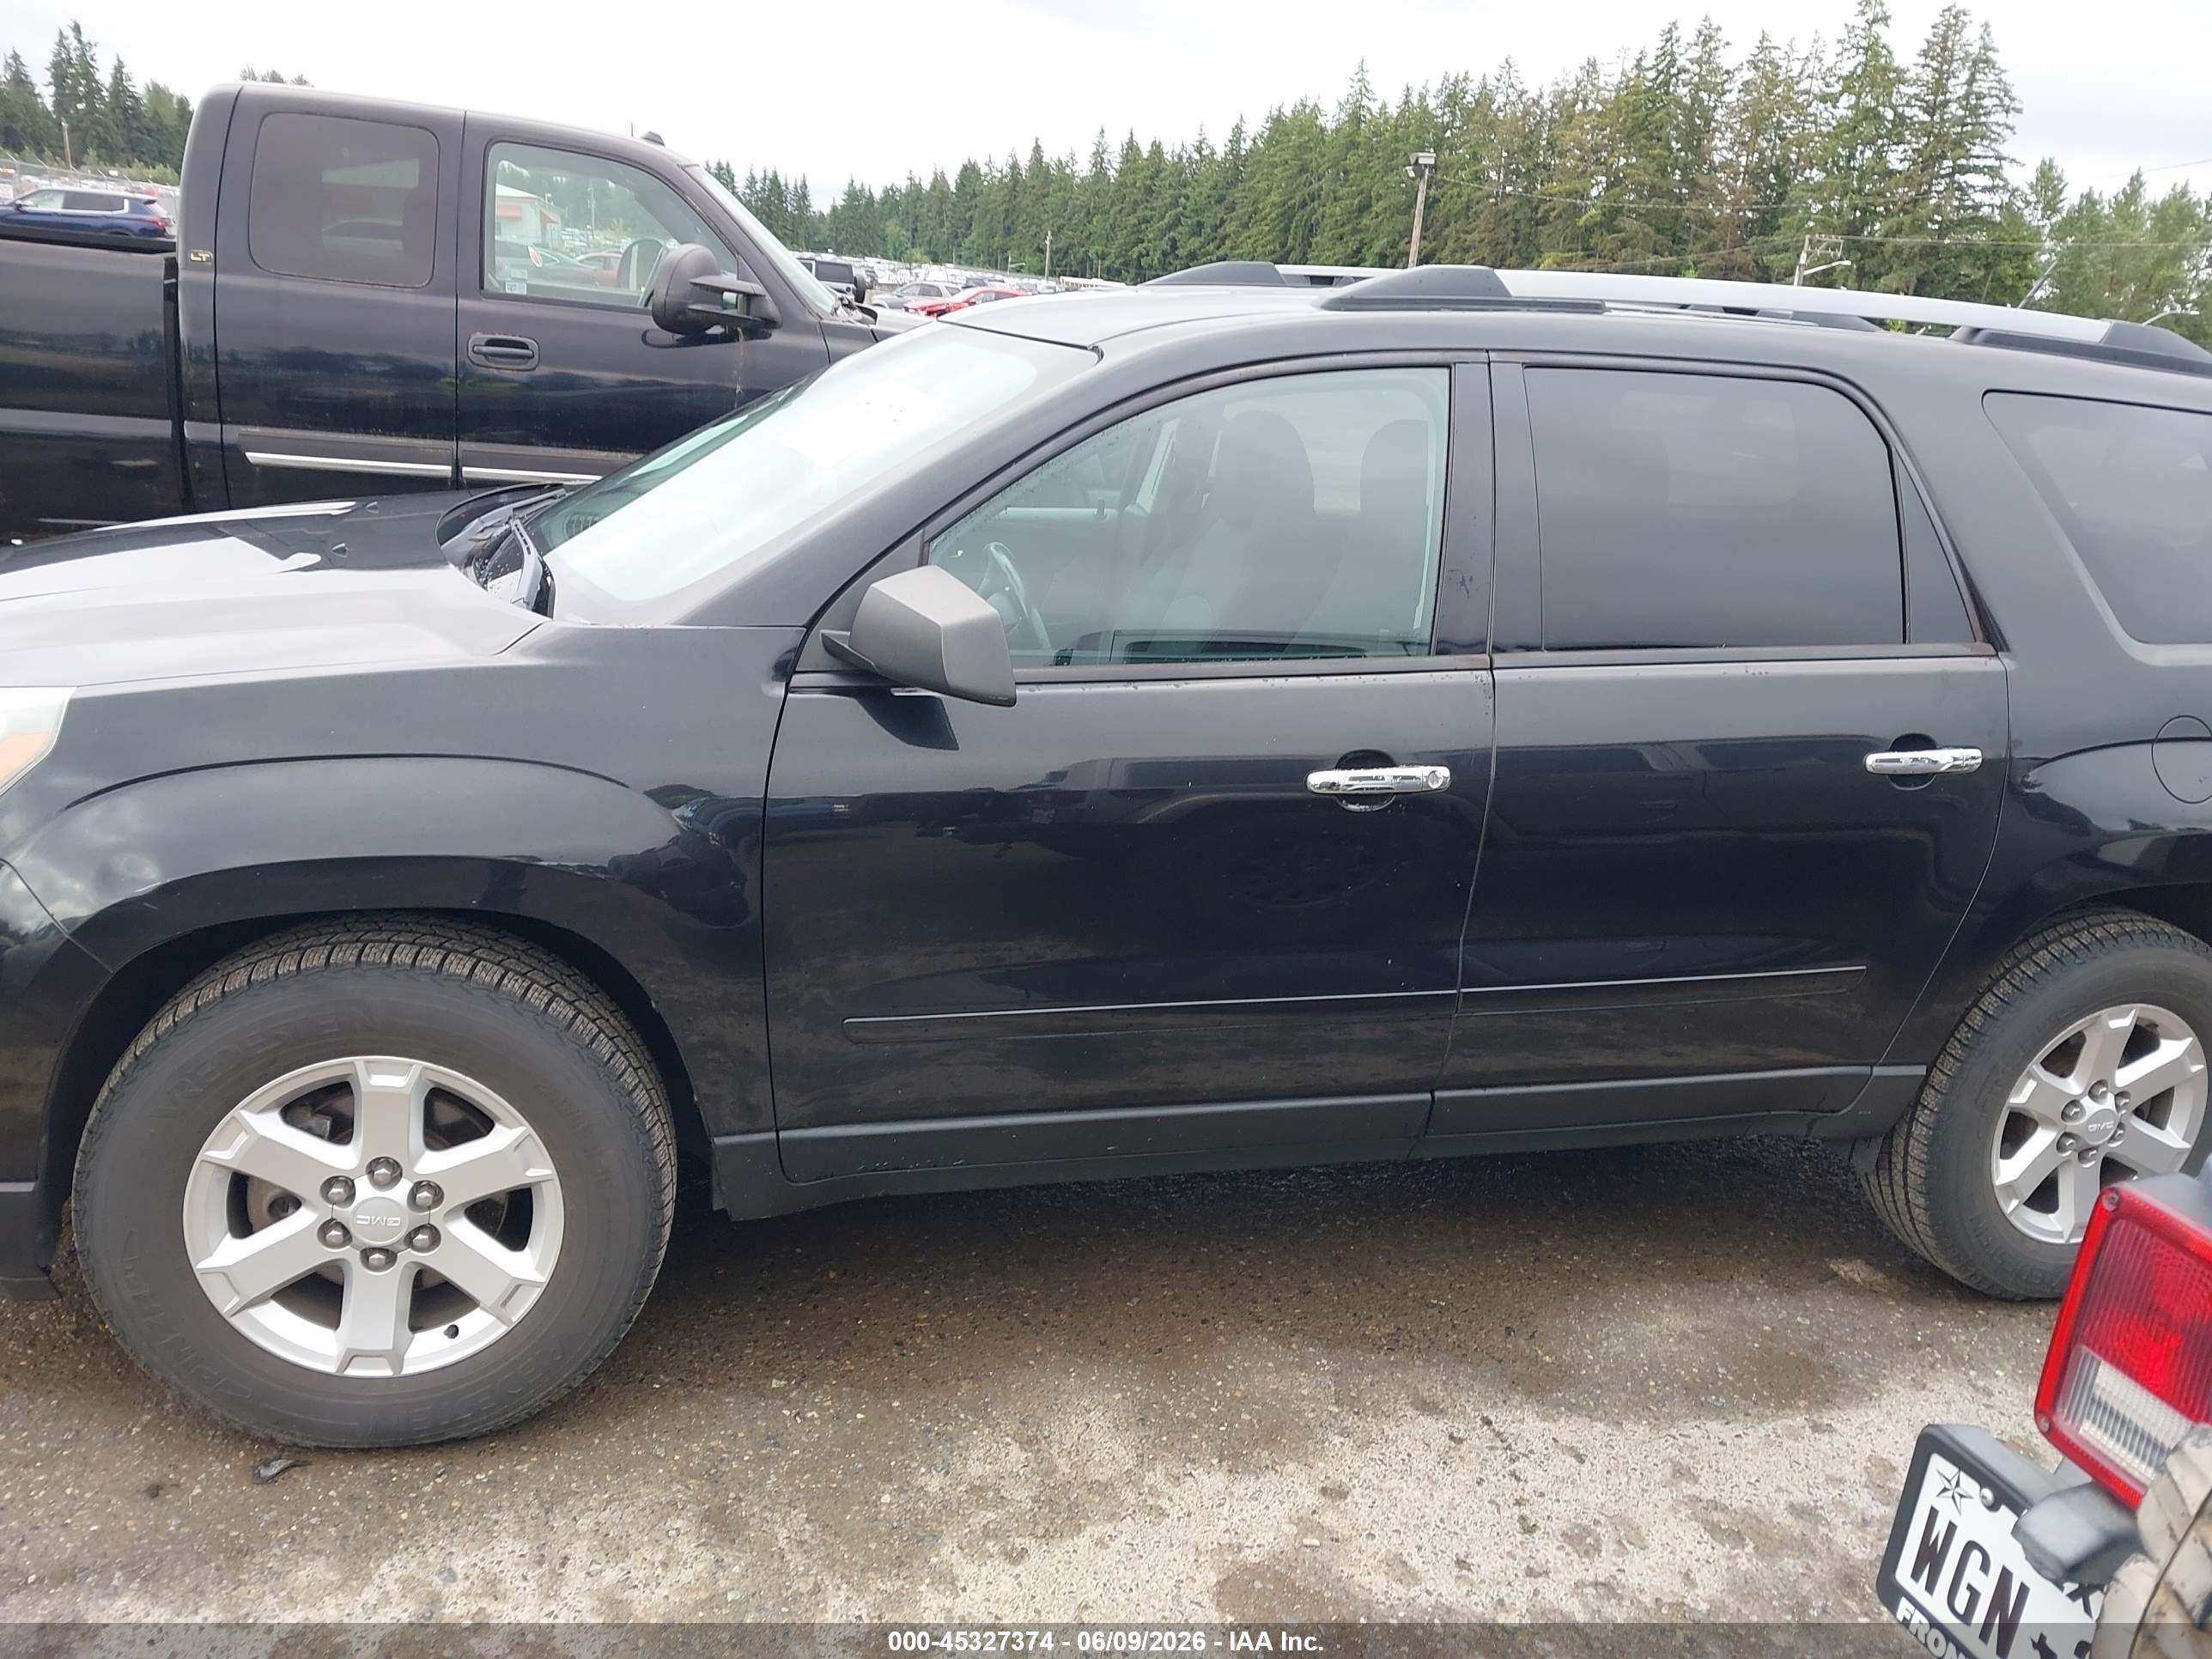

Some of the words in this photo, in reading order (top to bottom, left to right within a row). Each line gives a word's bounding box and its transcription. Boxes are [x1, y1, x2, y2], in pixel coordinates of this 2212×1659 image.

[190, 252, 210, 262] LT
[356, 1214, 402, 1227] GMC
[1910, 1504, 2031, 1659] WGN
